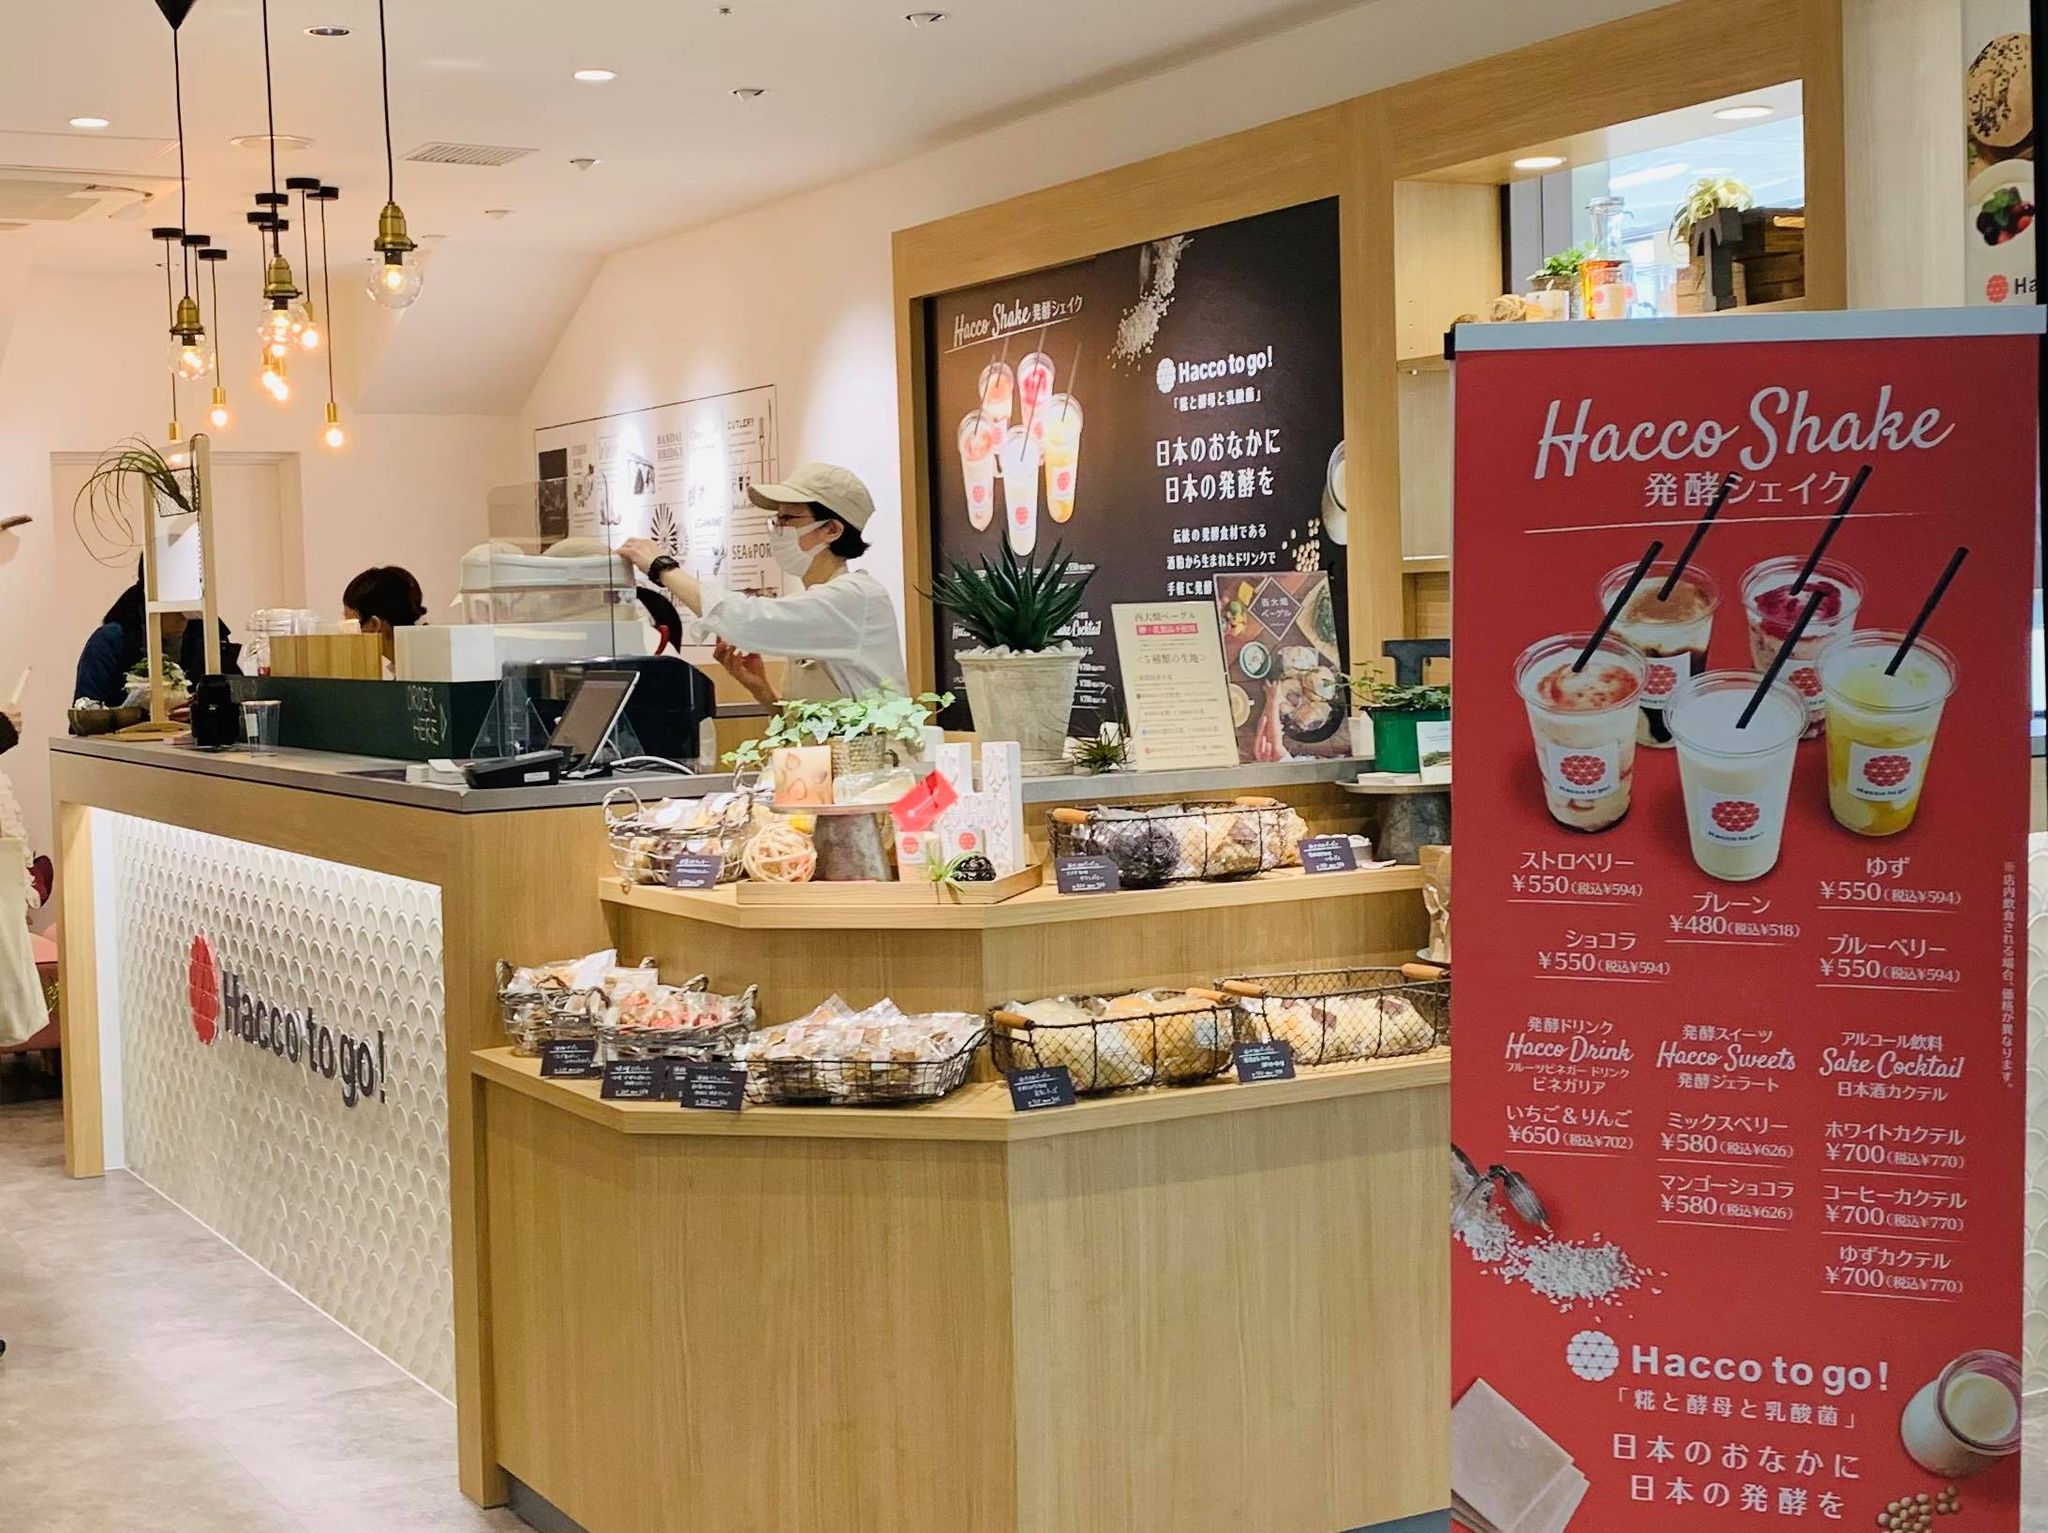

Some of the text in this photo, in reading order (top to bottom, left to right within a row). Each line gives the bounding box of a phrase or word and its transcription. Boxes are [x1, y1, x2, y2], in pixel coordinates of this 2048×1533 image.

[954, 294, 1083, 348] Hacco Shake 発酵シェイク
[1178, 345, 1273, 383] Hacco to go!
[1534, 385, 1956, 479] Hacco Shake
[1156, 427, 1281, 468] 日本のおなかに
[1165, 465, 1275, 503] 日本の発酵を
[1644, 470, 1853, 509] 発酵シェイク
[1520, 851, 1635, 873] ストロベリー
[1866, 857, 1911, 879] ゆず
[1693, 891, 1771, 914] プレーン
[1565, 929, 1637, 951] ショコラ
[1827, 934, 1947, 959] ブルーベリー
[1527, 1016, 1614, 1034] 発酵ドリンク
[1682, 1024, 1774, 1043] 発酵スイーツ
[223, 970, 388, 1108] Hacco to go!
[1505, 1032, 1634, 1063] Hacco Drink
[1841, 1031, 1943, 1051] アルコール飲料
[1656, 1041, 1796, 1073] Hacco Sweets
[1819, 1048, 1965, 1079] Sake Cocktail
[1591, 1067, 1630, 1079] ドリンク
[1677, 1072, 1780, 1092] 発酵ジェラート
[1533, 1077, 1606, 1095] ビネガリア
[1838, 1081, 1948, 1102] 日本酒カクテル
[1667, 1112, 1788, 1134] ミックスベリー
[1825, 1121, 1966, 1146] ホワイトカクテル
[1659, 1175, 1794, 1199] マンゴーショコラ
[1824, 1184, 1968, 1210] コーヒーカクテル
[1840, 1245, 1951, 1270] ゆずカクテル
[1631, 1344, 1889, 1395] Hacco to go!
[1617, 1387, 1857, 1429] 「糀と酵母と乳酸菌」
[1613, 1432, 1861, 1480] 日本のおなかに
[1630, 1475, 1846, 1520] 日本の発酵を
